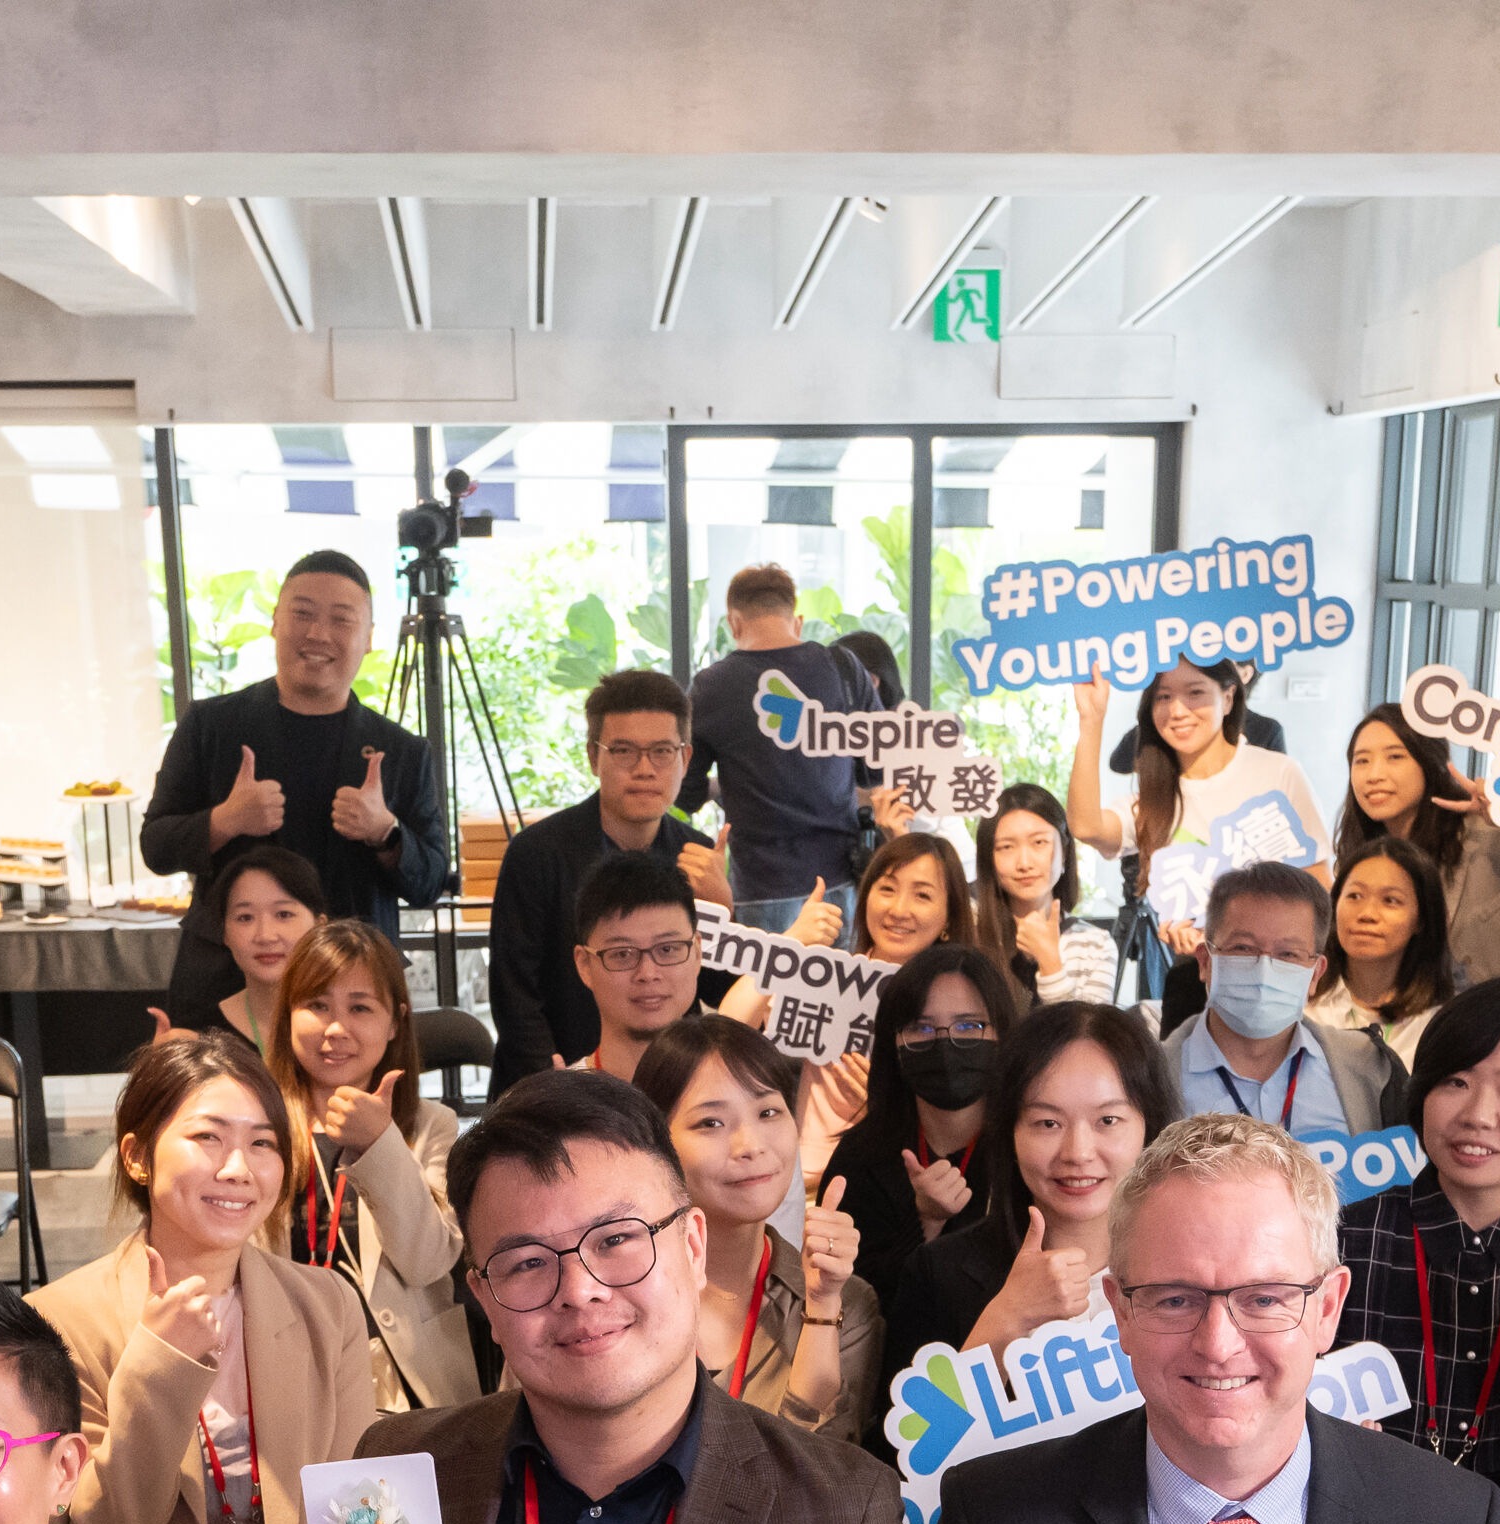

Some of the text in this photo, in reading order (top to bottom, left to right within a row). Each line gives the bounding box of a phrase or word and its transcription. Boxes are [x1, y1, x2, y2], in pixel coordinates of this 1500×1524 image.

[988, 541, 1309, 619] #Powering
[960, 598, 1349, 690] Young People
[806, 711, 960, 761] Inspire
[891, 764, 1000, 814] 啟發
[1159, 801, 1307, 920] 永續
